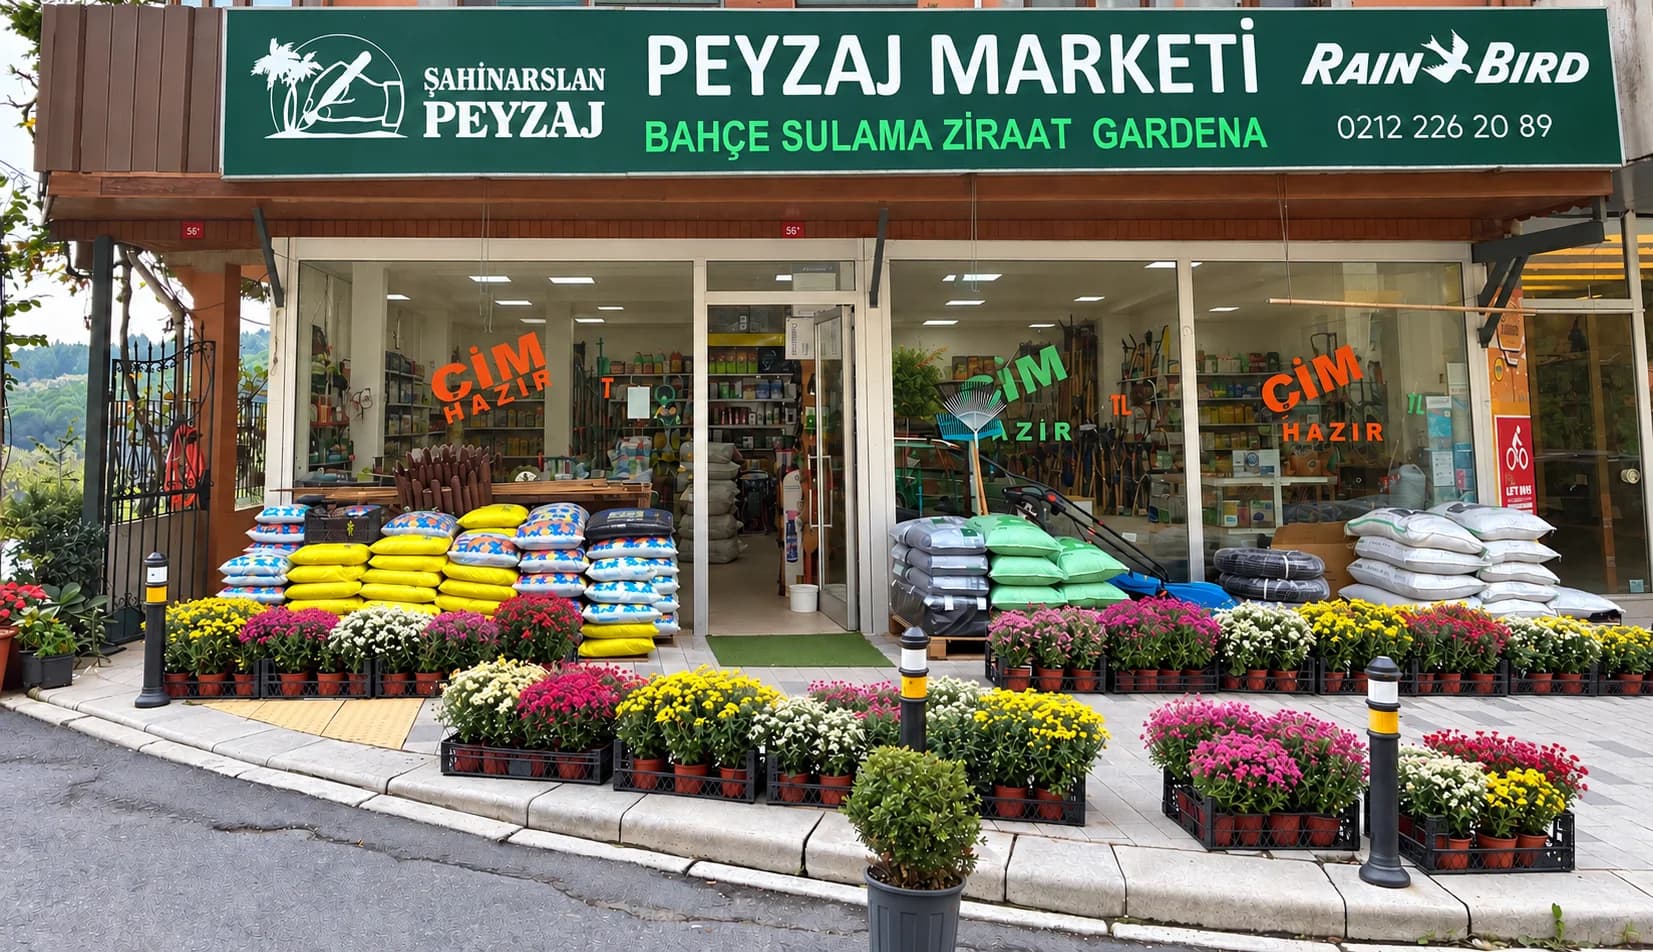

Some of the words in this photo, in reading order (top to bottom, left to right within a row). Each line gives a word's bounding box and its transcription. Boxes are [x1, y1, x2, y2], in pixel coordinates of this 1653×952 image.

[647, 34, 901, 96] PEYZAJ
[931, 17, 1258, 95] MARKETİ
[1301, 42, 1424, 84] RAIN
[1474, 41, 1590, 84] BIRD
[423, 61, 606, 97] ŞAHİNARSLAN
[423, 100, 605, 139] PEYZAJ
[645, 119, 769, 160] BAHÇE
[781, 119, 932, 152] SULAMA
[943, 111, 1072, 151] ZİRAAT
[1092, 116, 1268, 150] GARDENA
[1337, 114, 1403, 139] 0212
[1412, 114, 1463, 139] 226
[1473, 114, 1509, 139] 20
[1519, 114, 1553, 138] 89
[443, 369, 553, 425] HAZIR
[601, 377, 614, 398] T
[1261, 344, 1364, 413] ÇİM
[1110, 394, 1132, 416] TL
[1282, 421, 1384, 442] HAZIR
